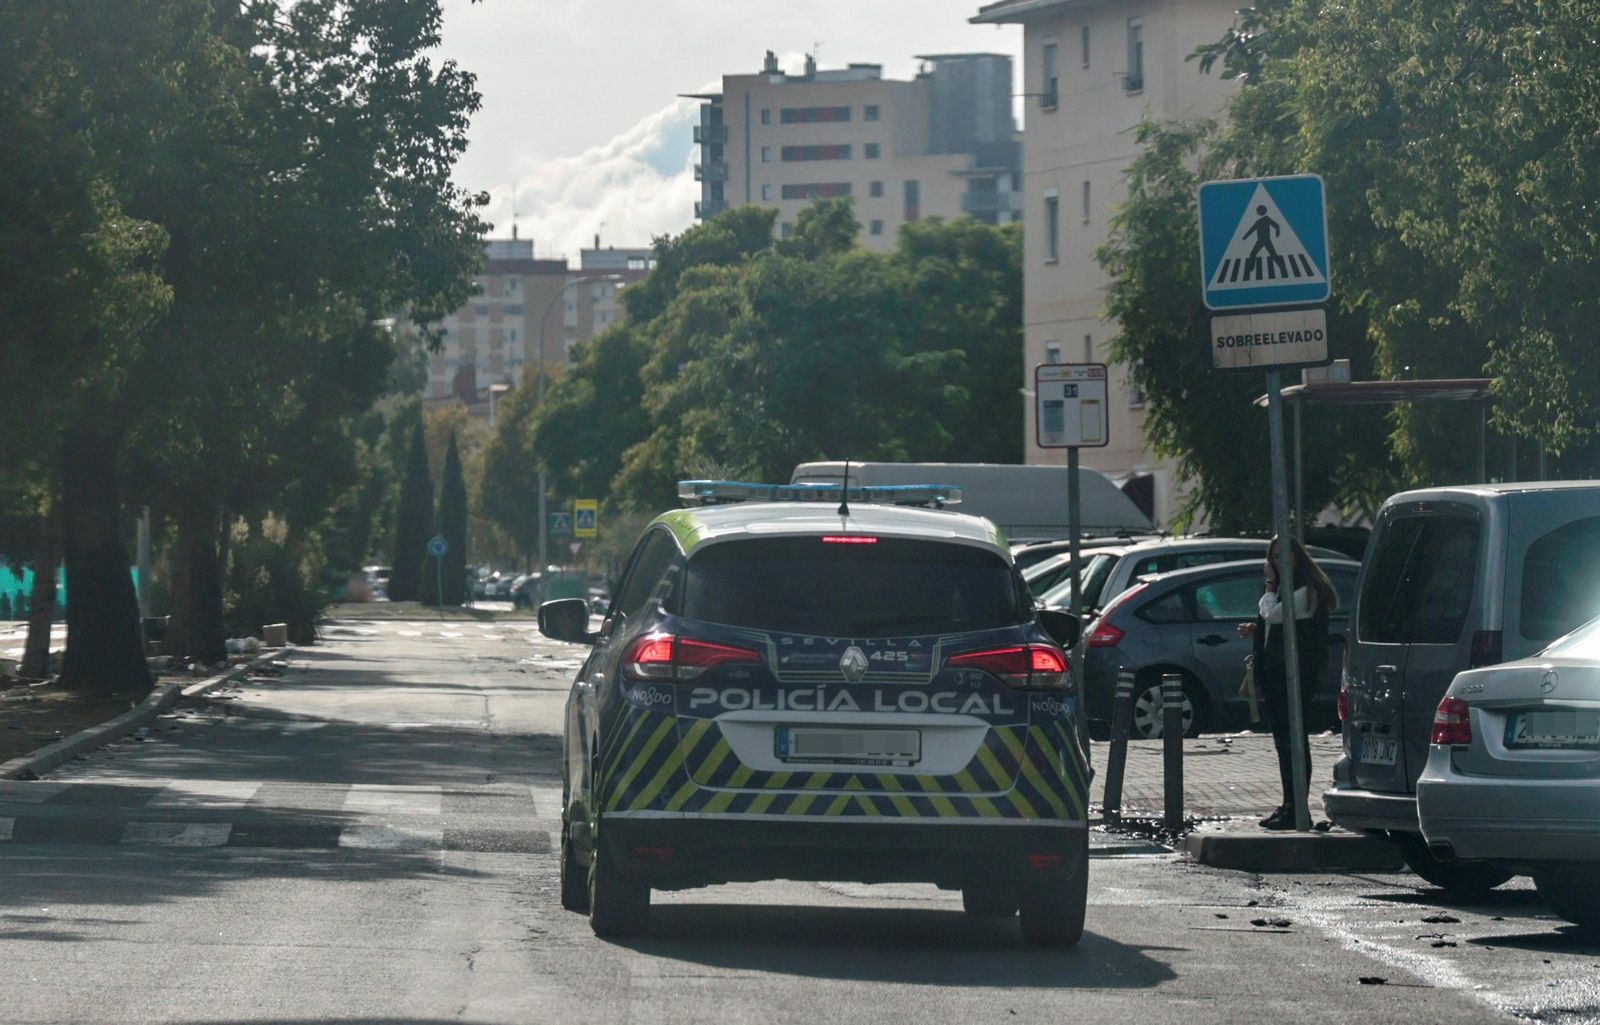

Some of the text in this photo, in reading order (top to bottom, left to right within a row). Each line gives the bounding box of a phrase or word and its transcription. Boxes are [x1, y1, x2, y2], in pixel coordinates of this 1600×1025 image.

[1216, 329, 1324, 348] SOBREELEVADO
[781, 637, 922, 647] SEVILLA
[870, 651, 908, 661] 425
[690, 684, 1015, 715] POLICÍA LOCAL
